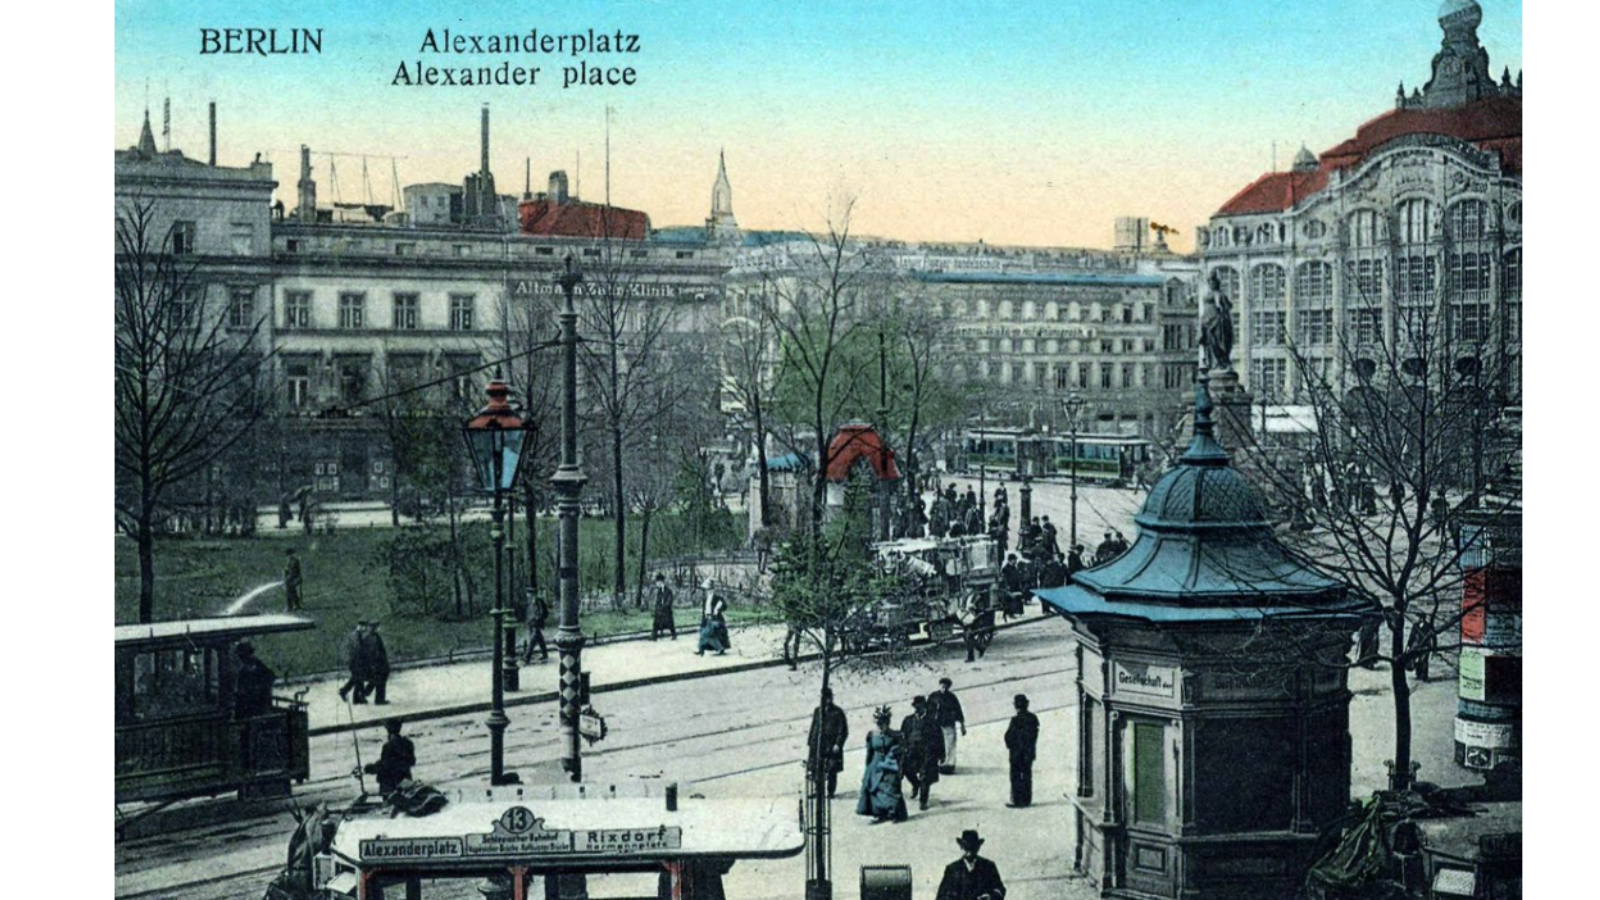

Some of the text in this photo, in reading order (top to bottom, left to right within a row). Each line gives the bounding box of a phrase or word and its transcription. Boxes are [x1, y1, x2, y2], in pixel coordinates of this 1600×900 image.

[516, 281, 583, 296] Altman
[507, 807, 527, 831] 13
[587, 826, 667, 843] Rixdorf
[364, 840, 459, 858] Alexanderplatz
